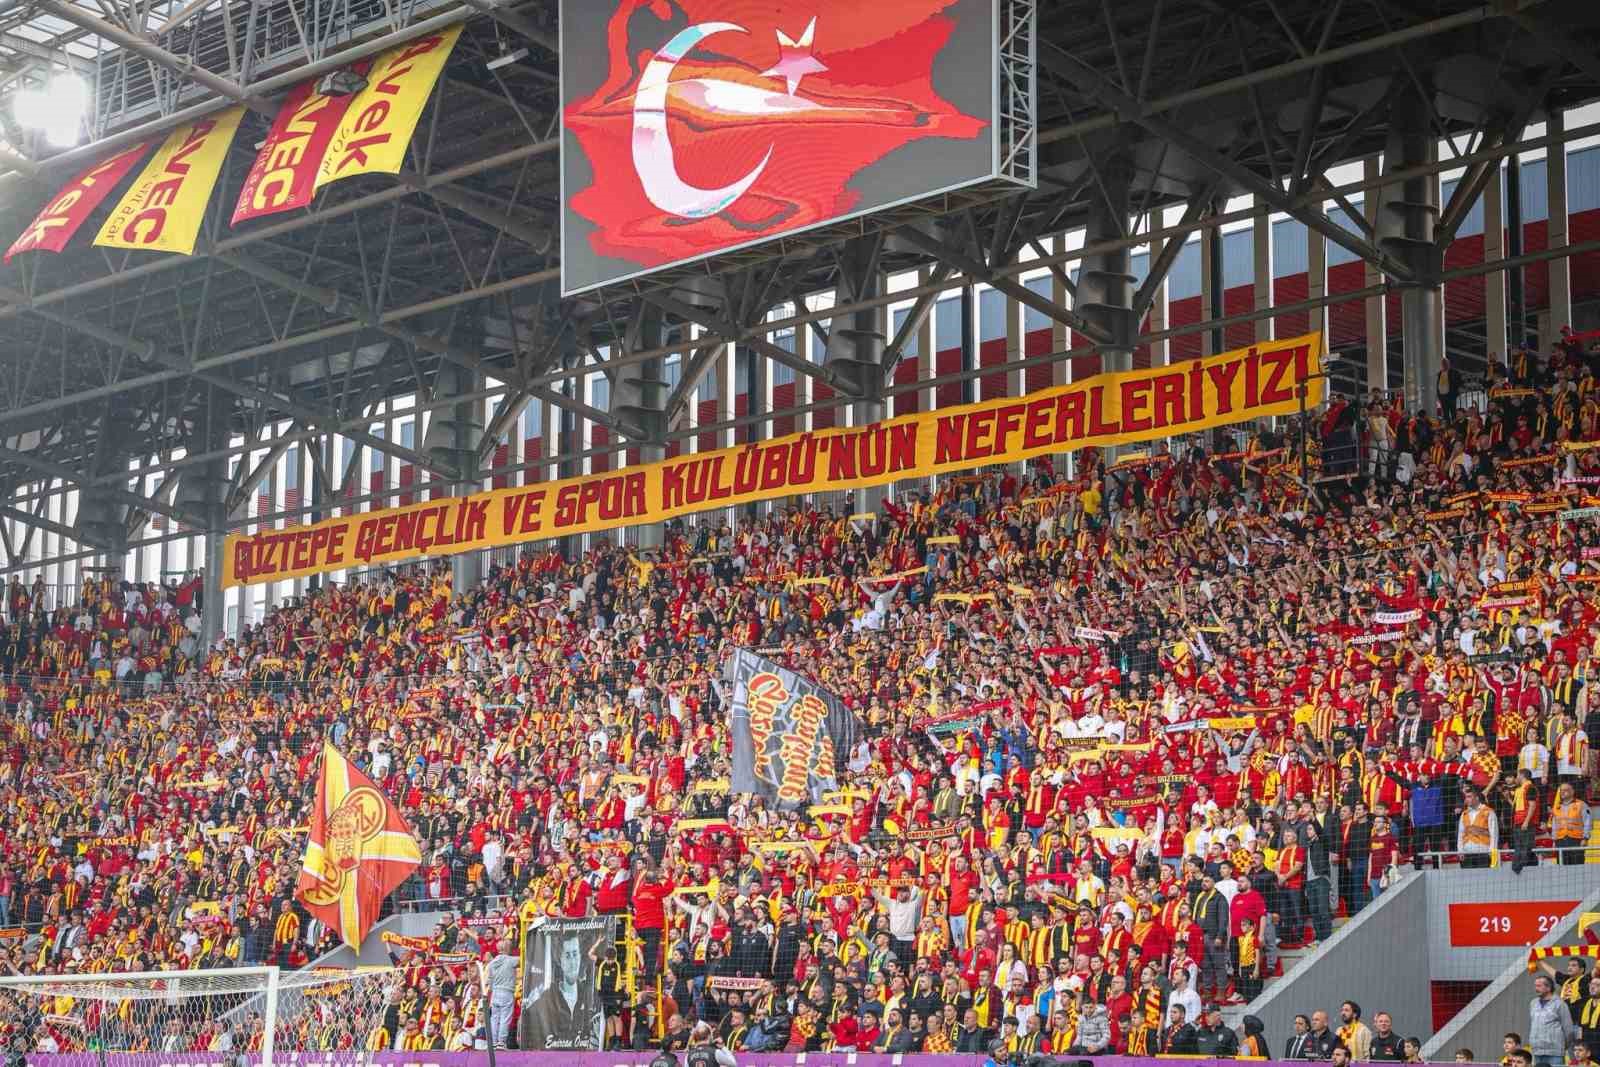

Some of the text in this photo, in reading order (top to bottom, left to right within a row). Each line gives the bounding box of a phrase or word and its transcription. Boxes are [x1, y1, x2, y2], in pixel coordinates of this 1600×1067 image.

[234, 344, 1311, 584] GÖZTEPE GENÇLİK VE SPOR KULÜBÜ'NÜN NEFERLERİYİZ!
[1479, 916, 1512, 933] 219
